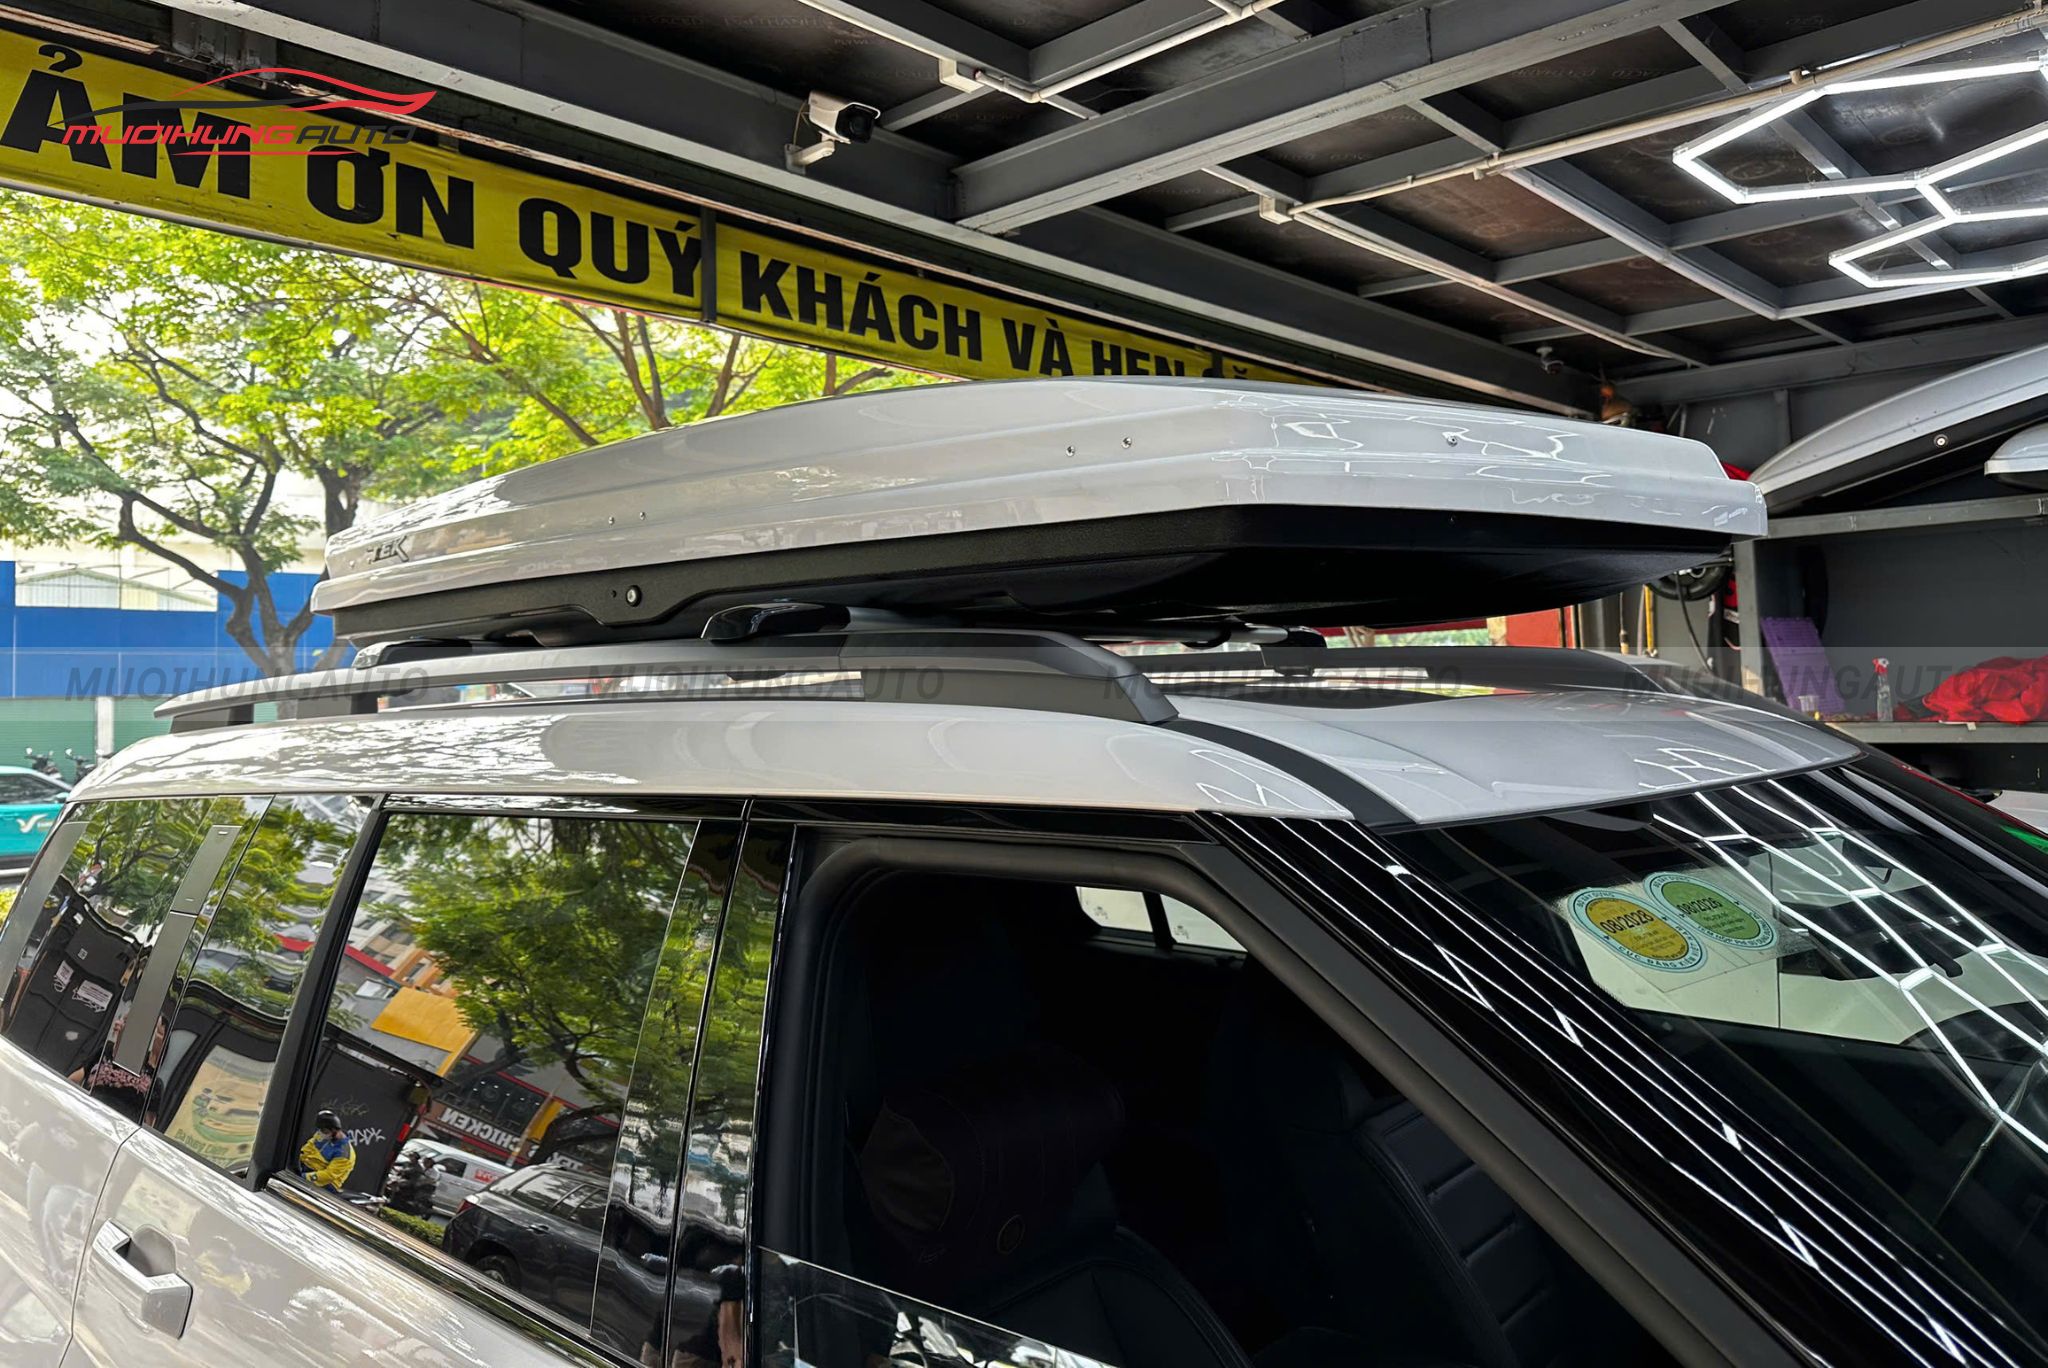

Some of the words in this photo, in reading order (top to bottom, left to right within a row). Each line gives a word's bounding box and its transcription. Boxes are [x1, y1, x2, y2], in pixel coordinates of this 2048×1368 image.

[306, 143, 475, 250] ƠN
[517, 197, 702, 300] QUÝ
[740, 250, 983, 363] KHÁCH
[1002, 314, 1073, 377] VÀ
